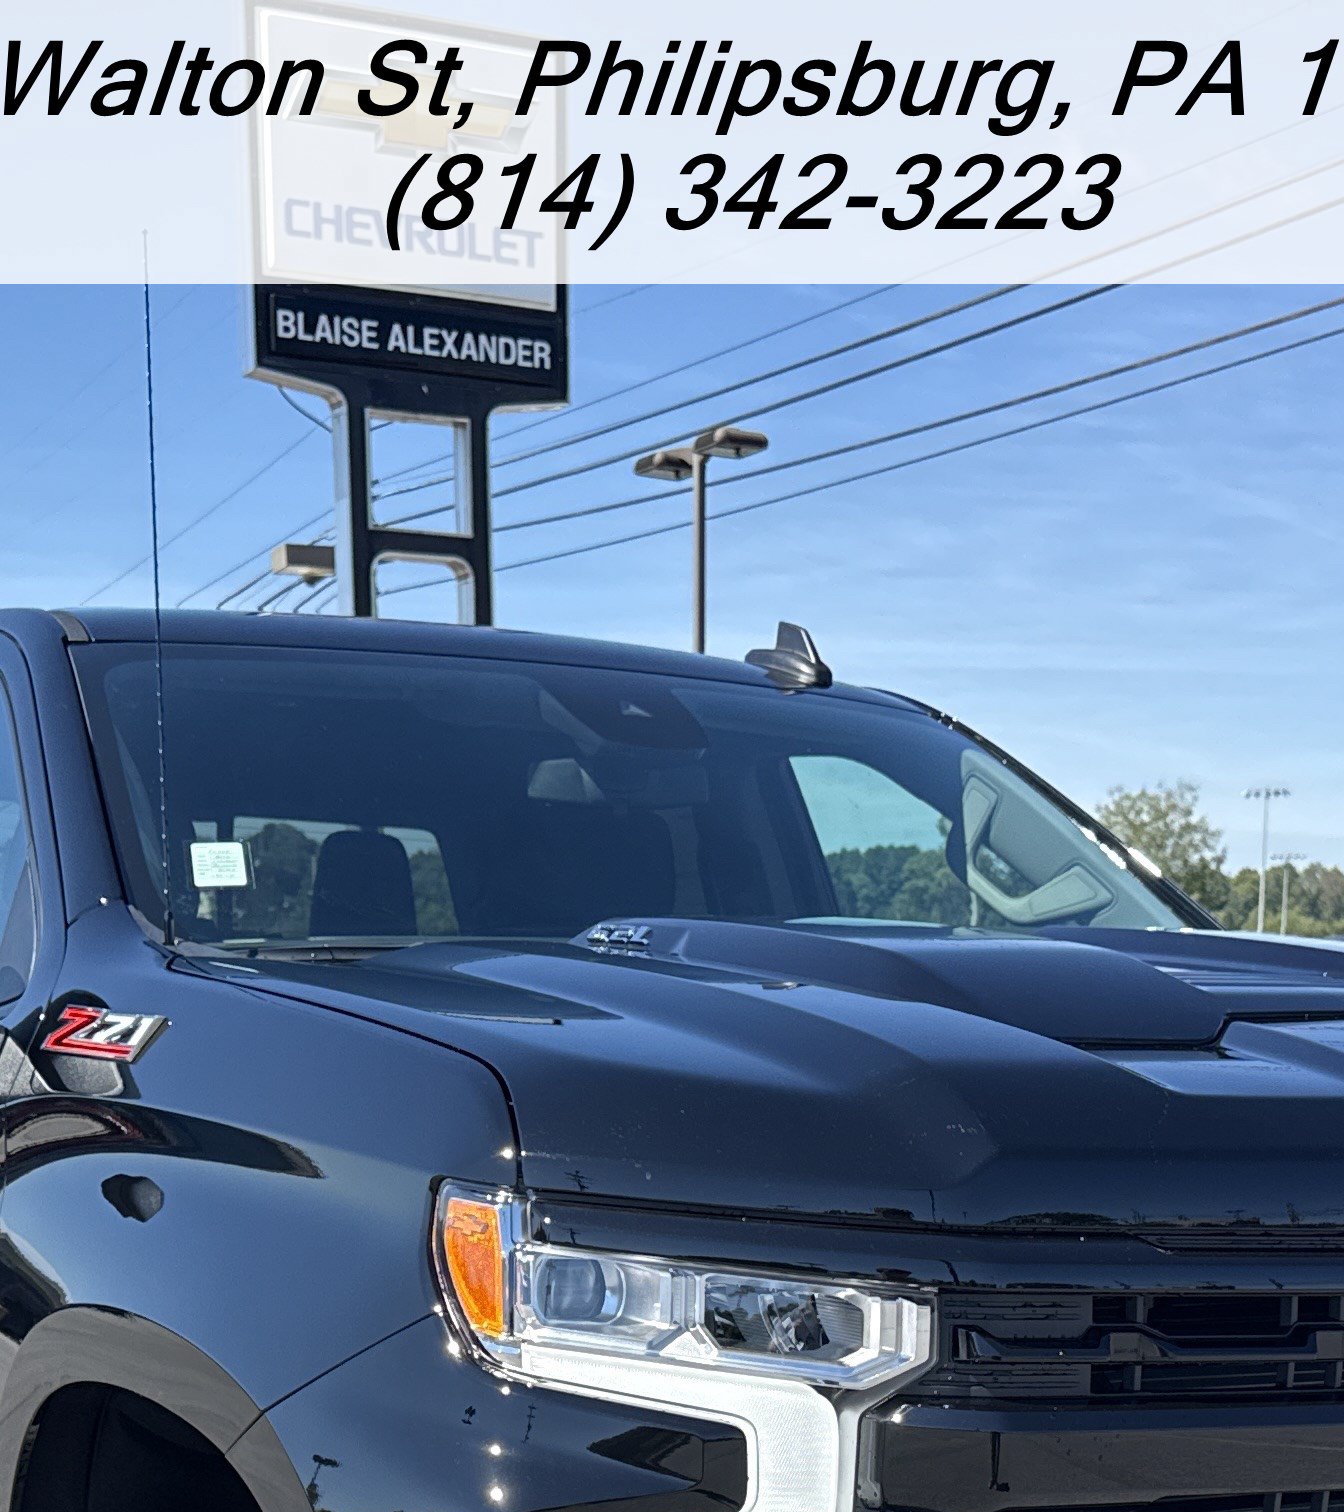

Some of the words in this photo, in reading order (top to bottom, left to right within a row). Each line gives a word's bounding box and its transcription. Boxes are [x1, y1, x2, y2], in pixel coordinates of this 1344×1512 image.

[282, 197, 544, 270] CHEVROLET
[275, 307, 379, 350] BLAISE
[387, 323, 553, 371] ALEXANDER
[40, 1003, 168, 1064] Z71
